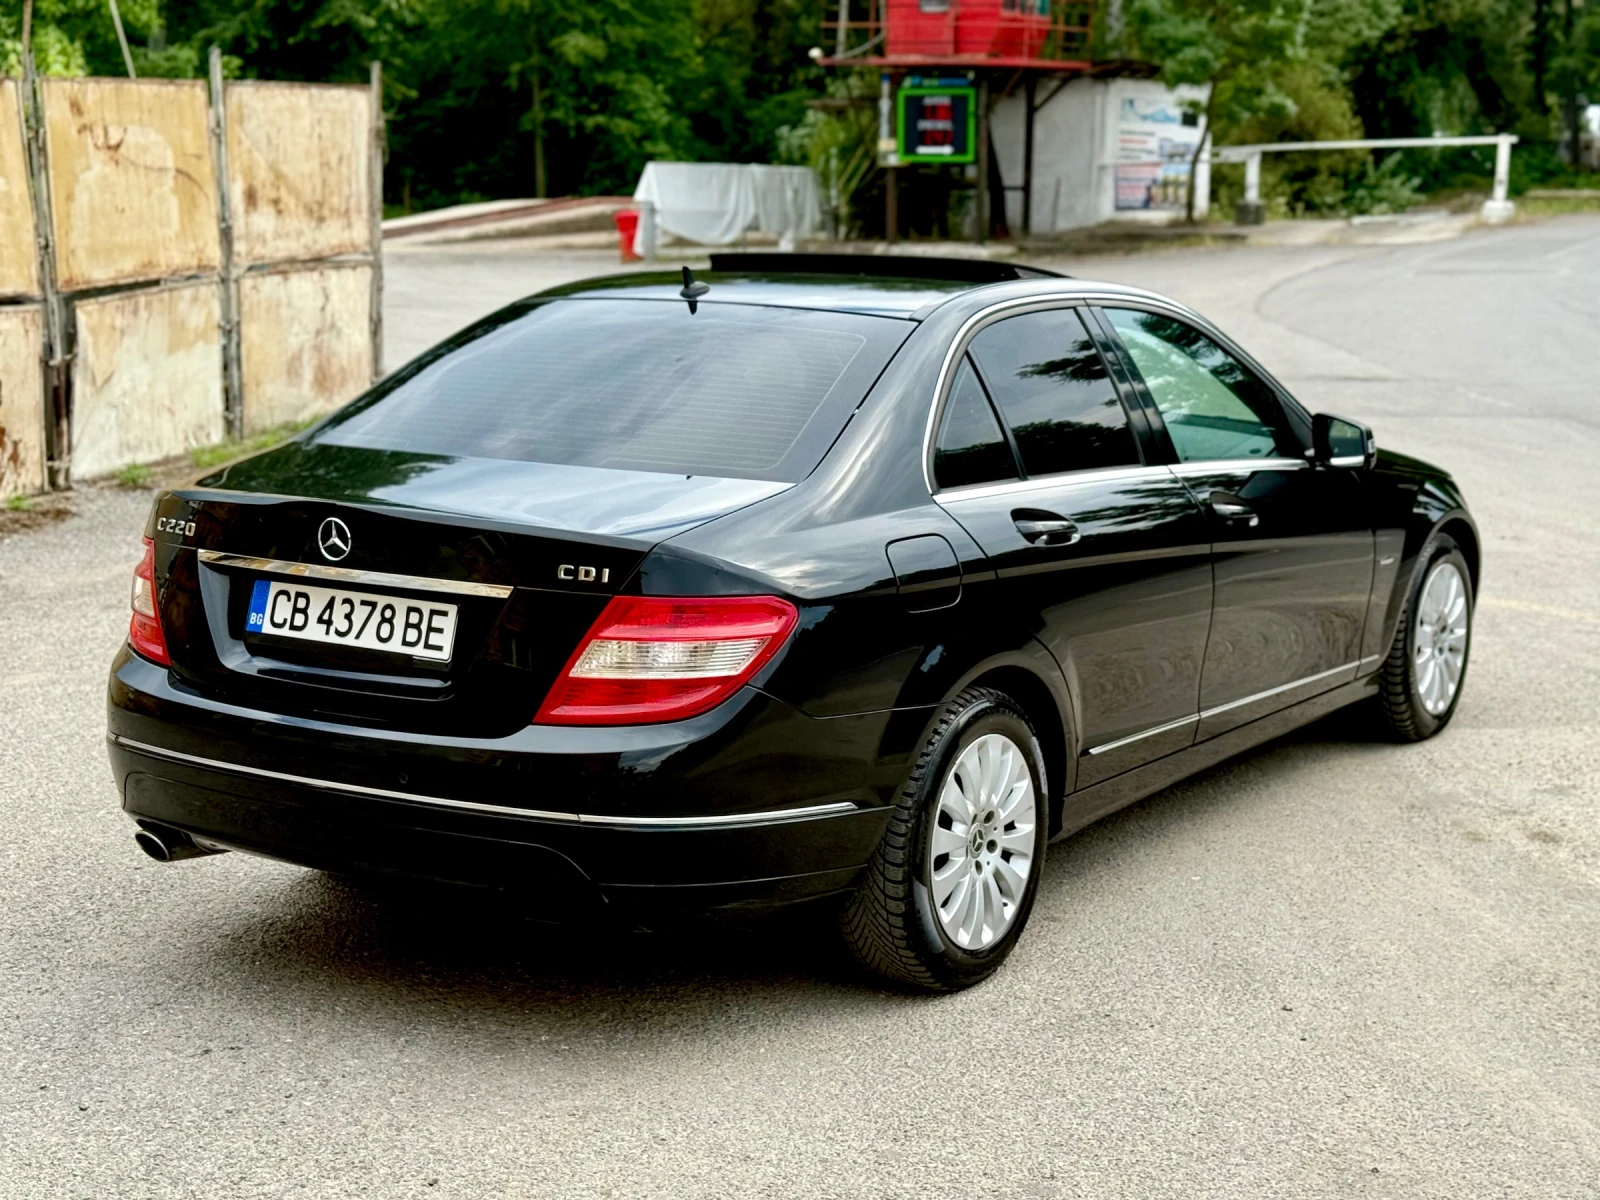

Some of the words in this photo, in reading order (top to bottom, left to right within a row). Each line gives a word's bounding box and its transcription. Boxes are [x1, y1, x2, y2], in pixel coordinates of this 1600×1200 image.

[157, 517, 196, 537] C220
[557, 564, 610, 583] CDI
[250, 612, 263, 625] BG
[269, 589, 311, 632] CB
[316, 595, 397, 644] 4378
[401, 605, 449, 652] BE
